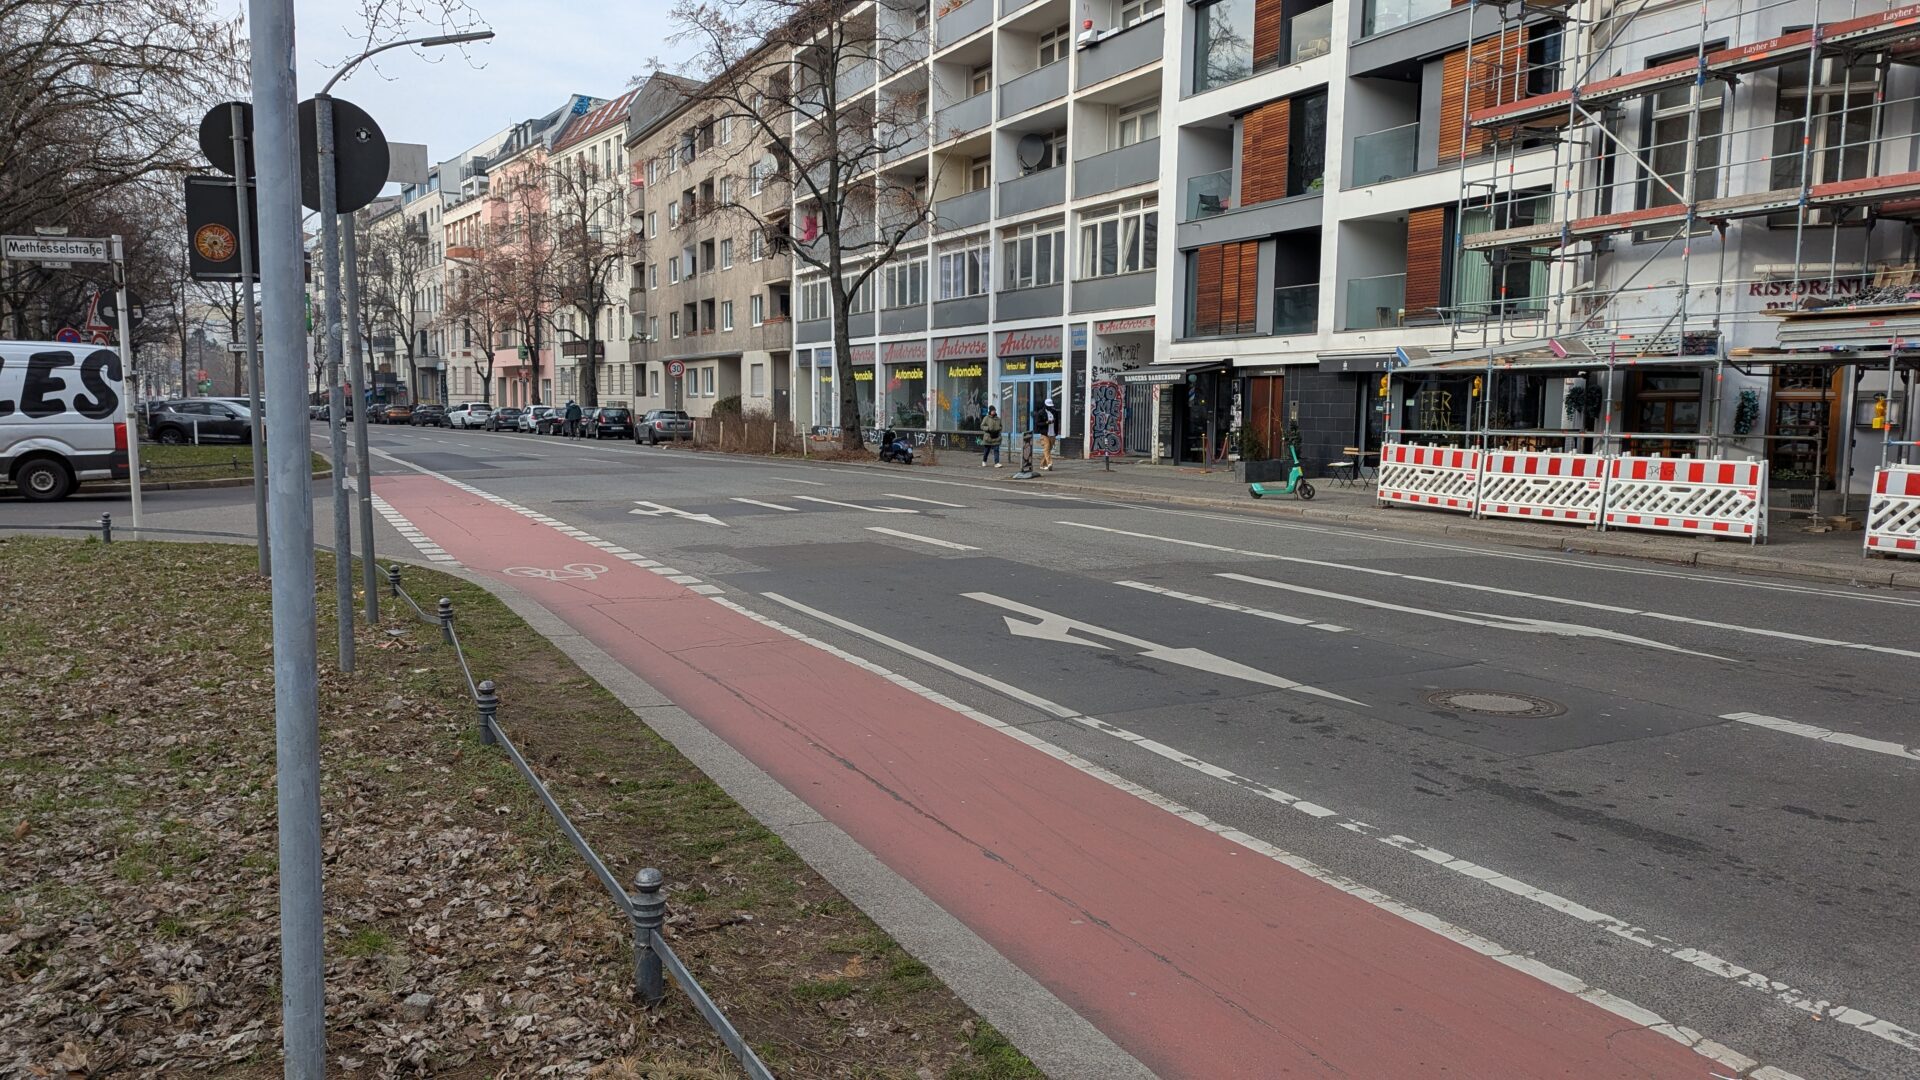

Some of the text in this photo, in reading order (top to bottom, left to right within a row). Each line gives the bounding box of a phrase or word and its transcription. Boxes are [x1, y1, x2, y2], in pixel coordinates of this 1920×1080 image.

[8, 241, 102, 256] Methfesselstraße
[1104, 319, 1147, 332] Autorose
[937, 337, 987, 358] Autorose
[1000, 332, 1060, 355] Autorose
[672, 364, 681, 373] 30
[895, 368, 924, 379] Automobile
[948, 364, 982, 378] Automobile
[853, 370, 873, 381] tomobile
